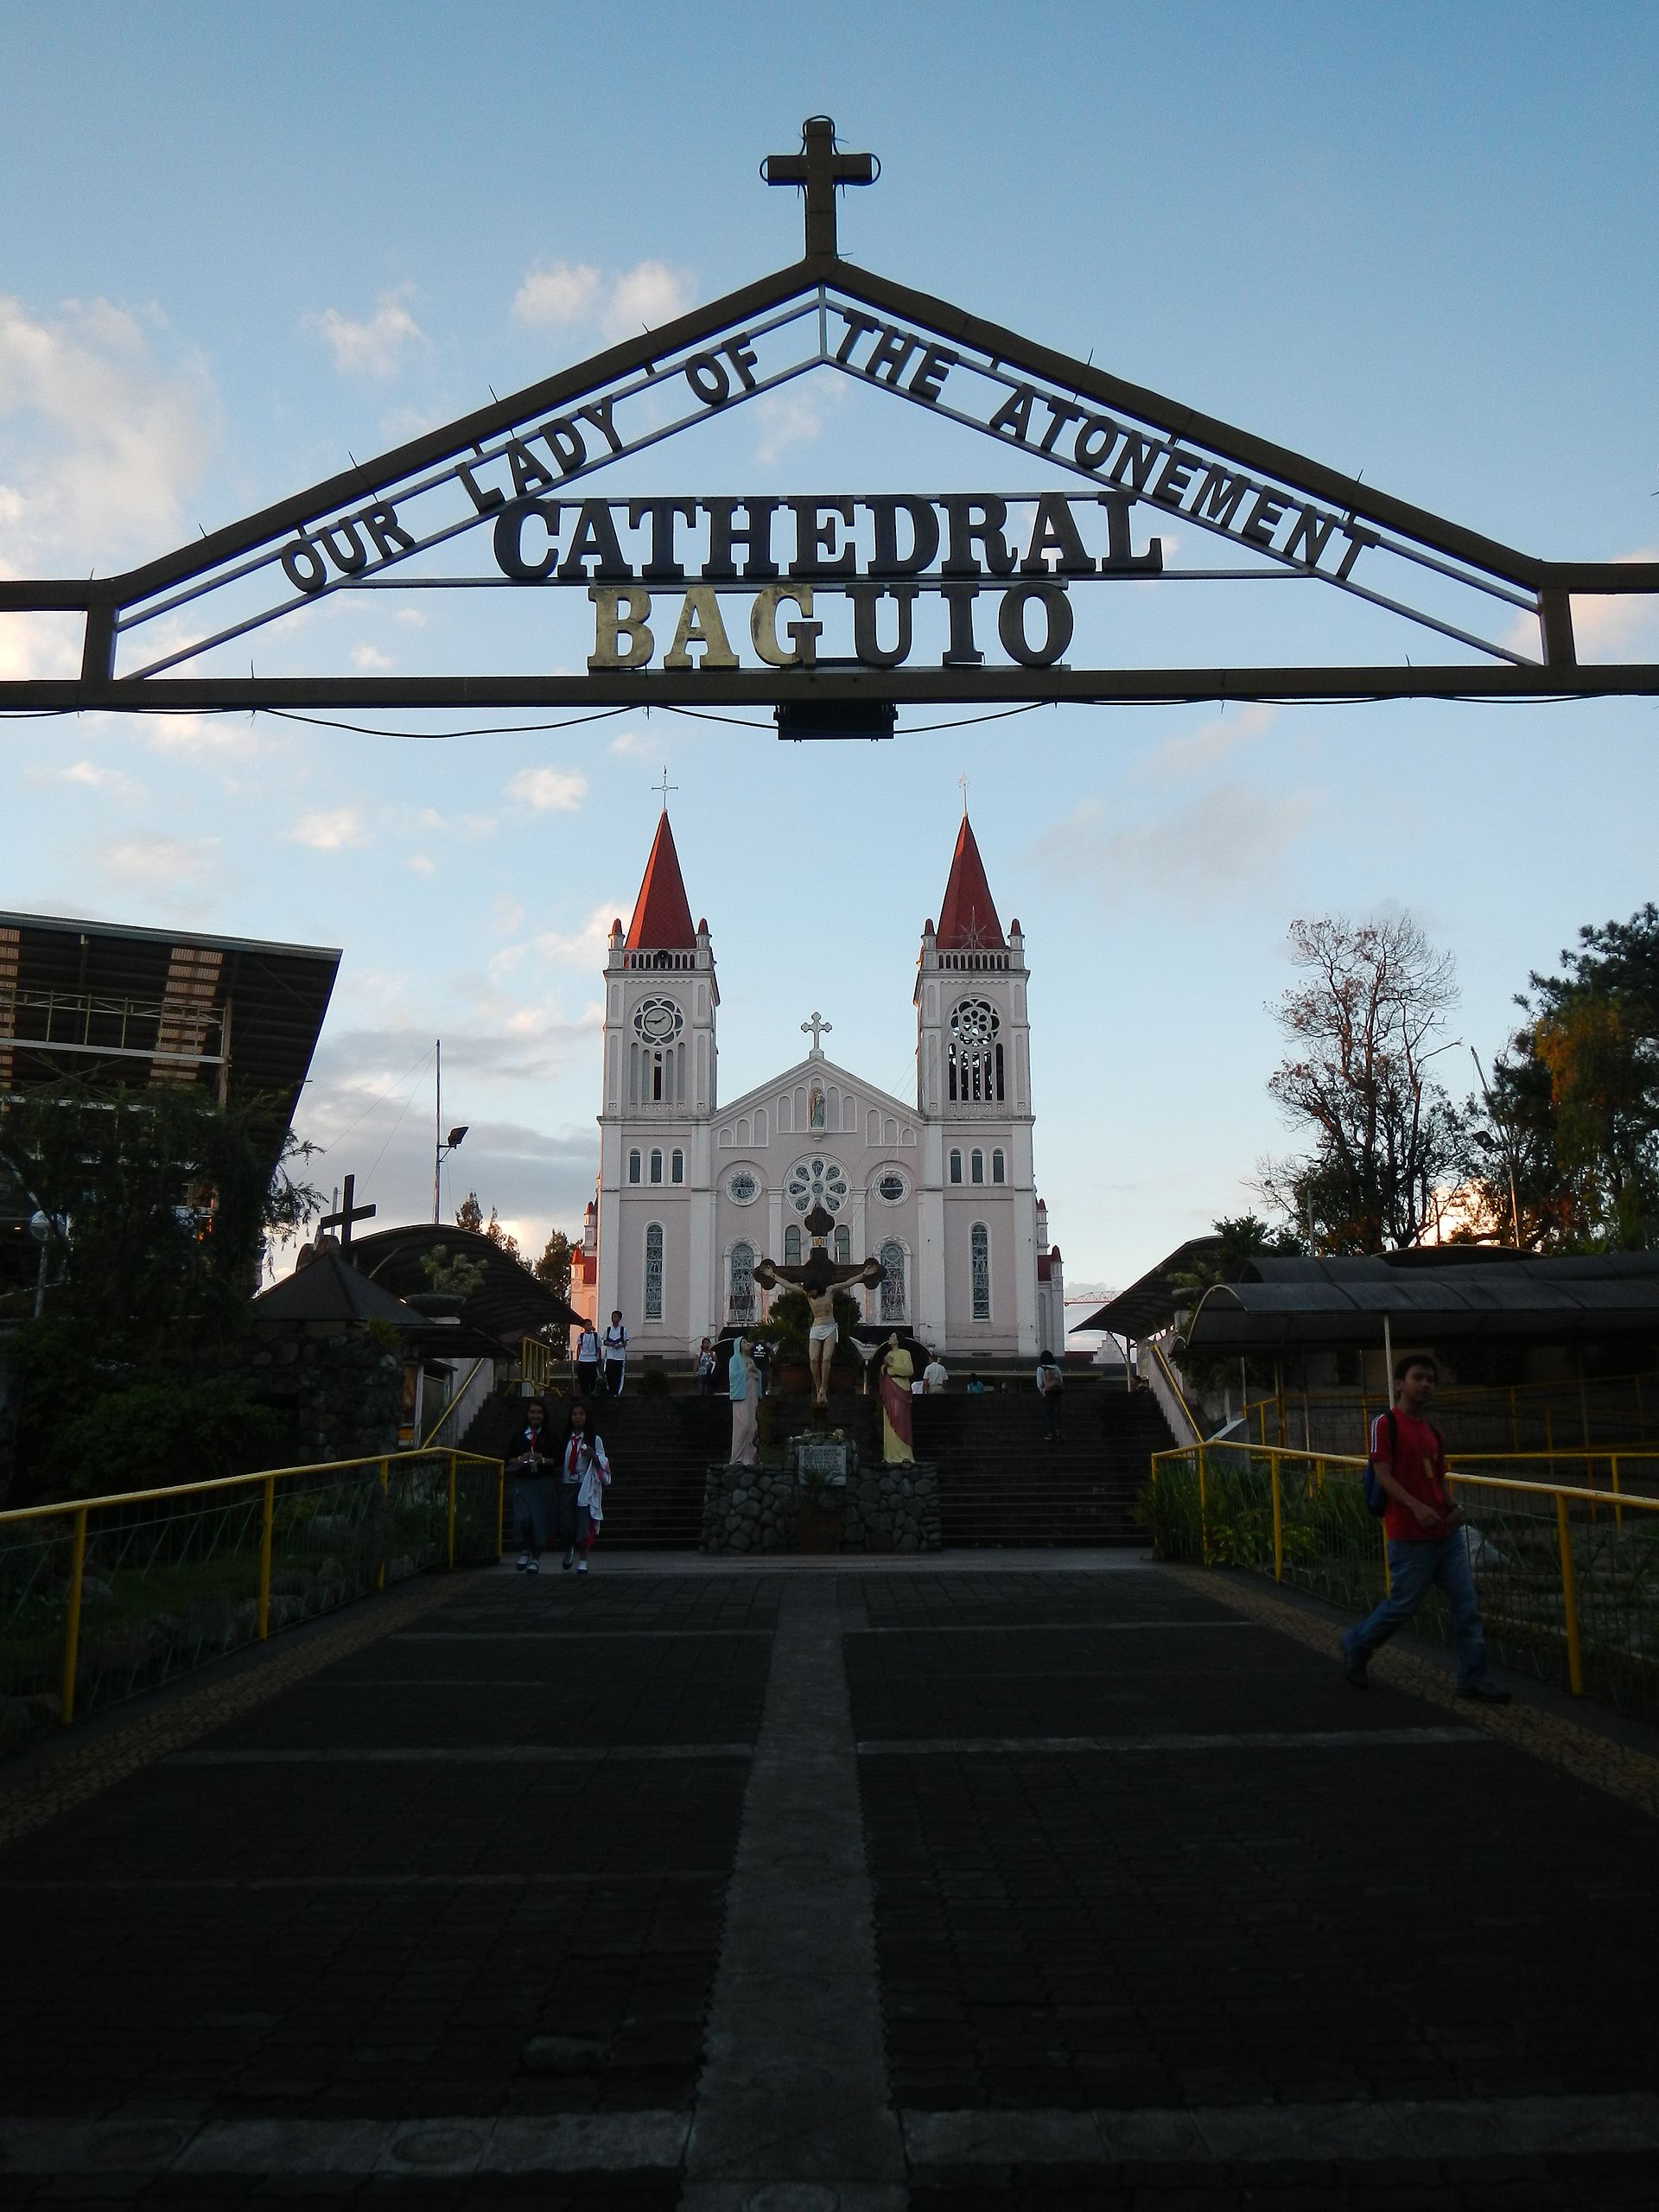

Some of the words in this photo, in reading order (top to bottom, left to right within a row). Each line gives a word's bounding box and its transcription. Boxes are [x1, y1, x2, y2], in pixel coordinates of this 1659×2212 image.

[281, 501, 414, 593] OUR
[455, 395, 623, 514] LADY
[684, 333, 758, 404] OF
[836, 308, 958, 402] THE
[989, 382, 1381, 580] ATONEMENT
[494, 492, 1163, 581] CATHEDRAL
[588, 582, 1074, 670] BAGUIO
